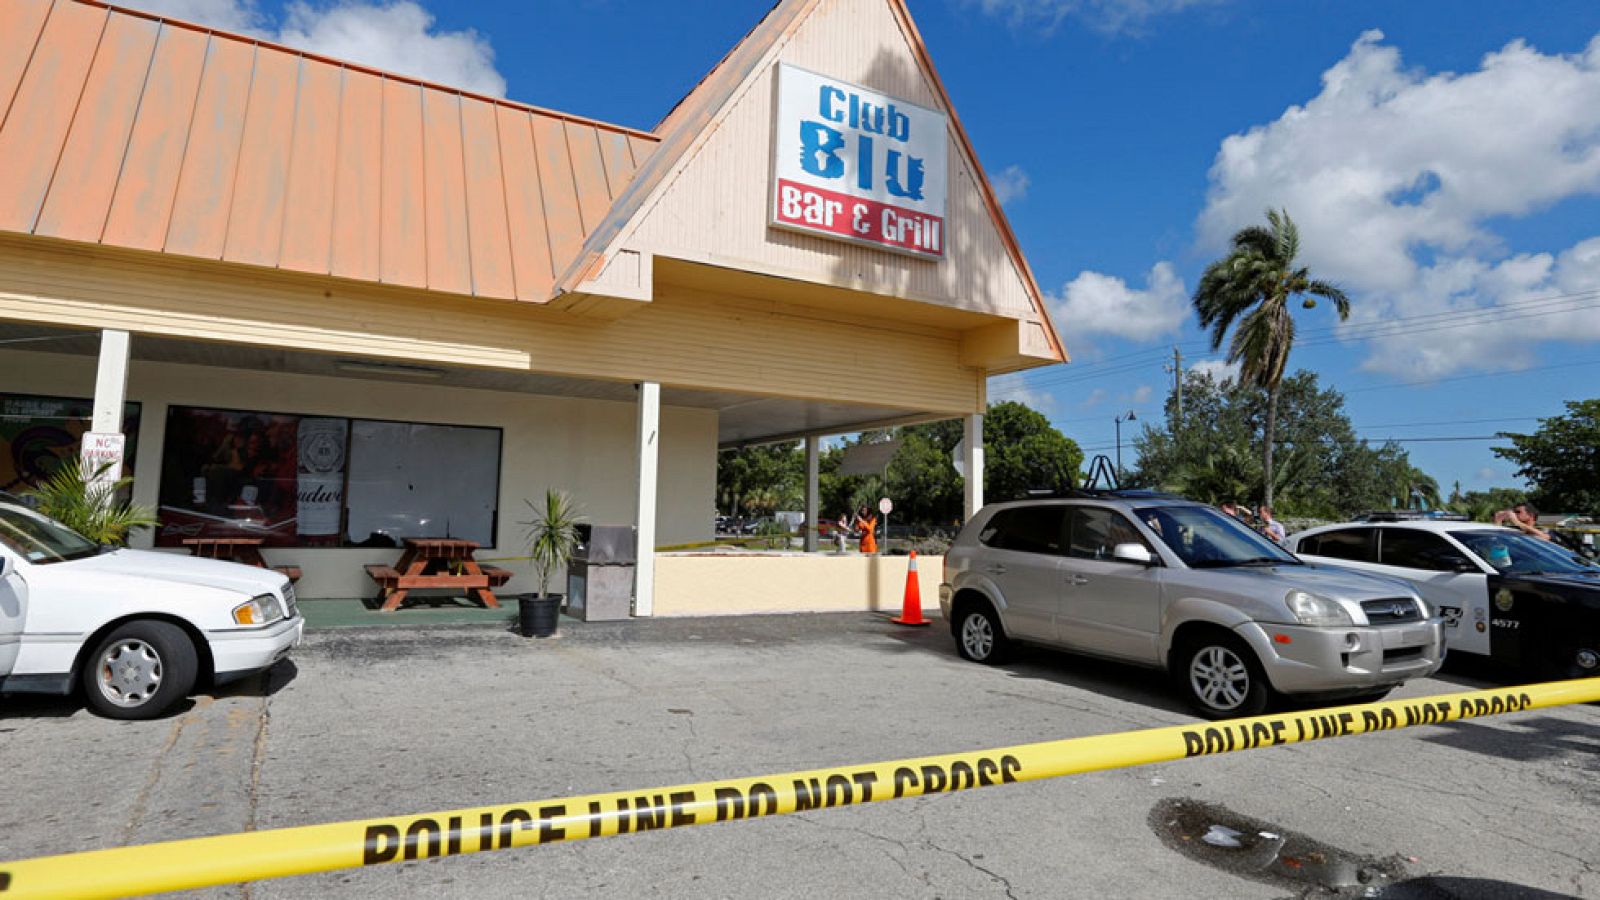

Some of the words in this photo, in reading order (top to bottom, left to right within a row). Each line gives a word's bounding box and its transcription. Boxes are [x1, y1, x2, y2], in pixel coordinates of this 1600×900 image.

[819, 84, 910, 142] Club
[781, 185, 843, 227] Bar
[852, 203, 871, 234] &
[881, 208, 941, 250] Grill
[714, 782, 778, 822] DO
[793, 770, 878, 812] NOT
